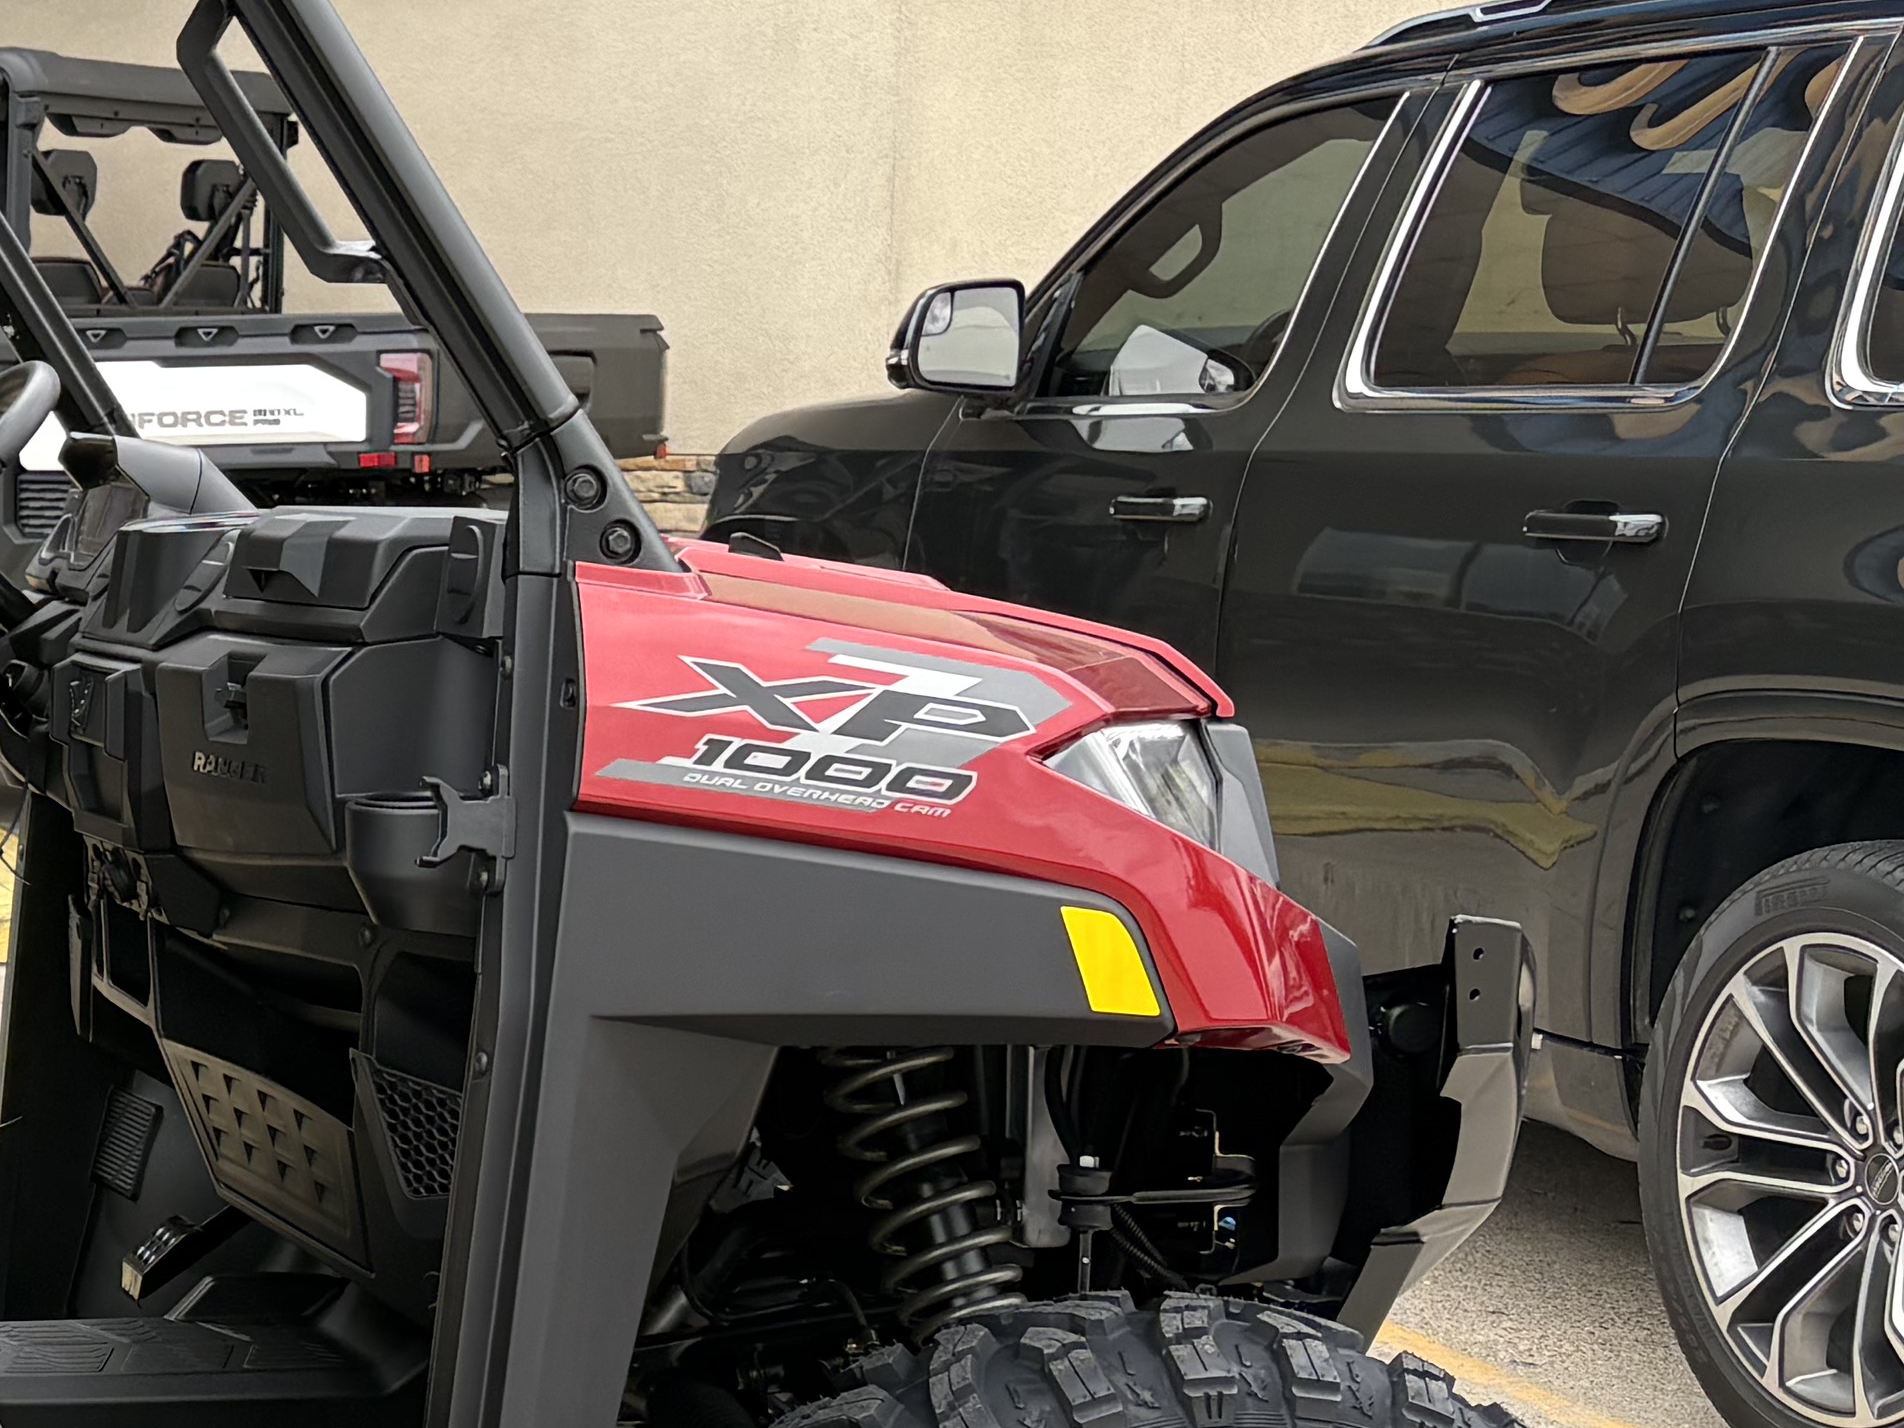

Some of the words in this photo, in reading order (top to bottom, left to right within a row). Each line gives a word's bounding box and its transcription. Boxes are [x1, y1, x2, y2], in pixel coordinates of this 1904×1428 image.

[130, 408, 248, 429] FORCE
[609, 654, 1037, 746] XP
[682, 772, 748, 791] DUAL
[753, 781, 892, 810] OVERHEAD
[894, 801, 952, 818] CAM
[694, 732, 978, 804] 1000
